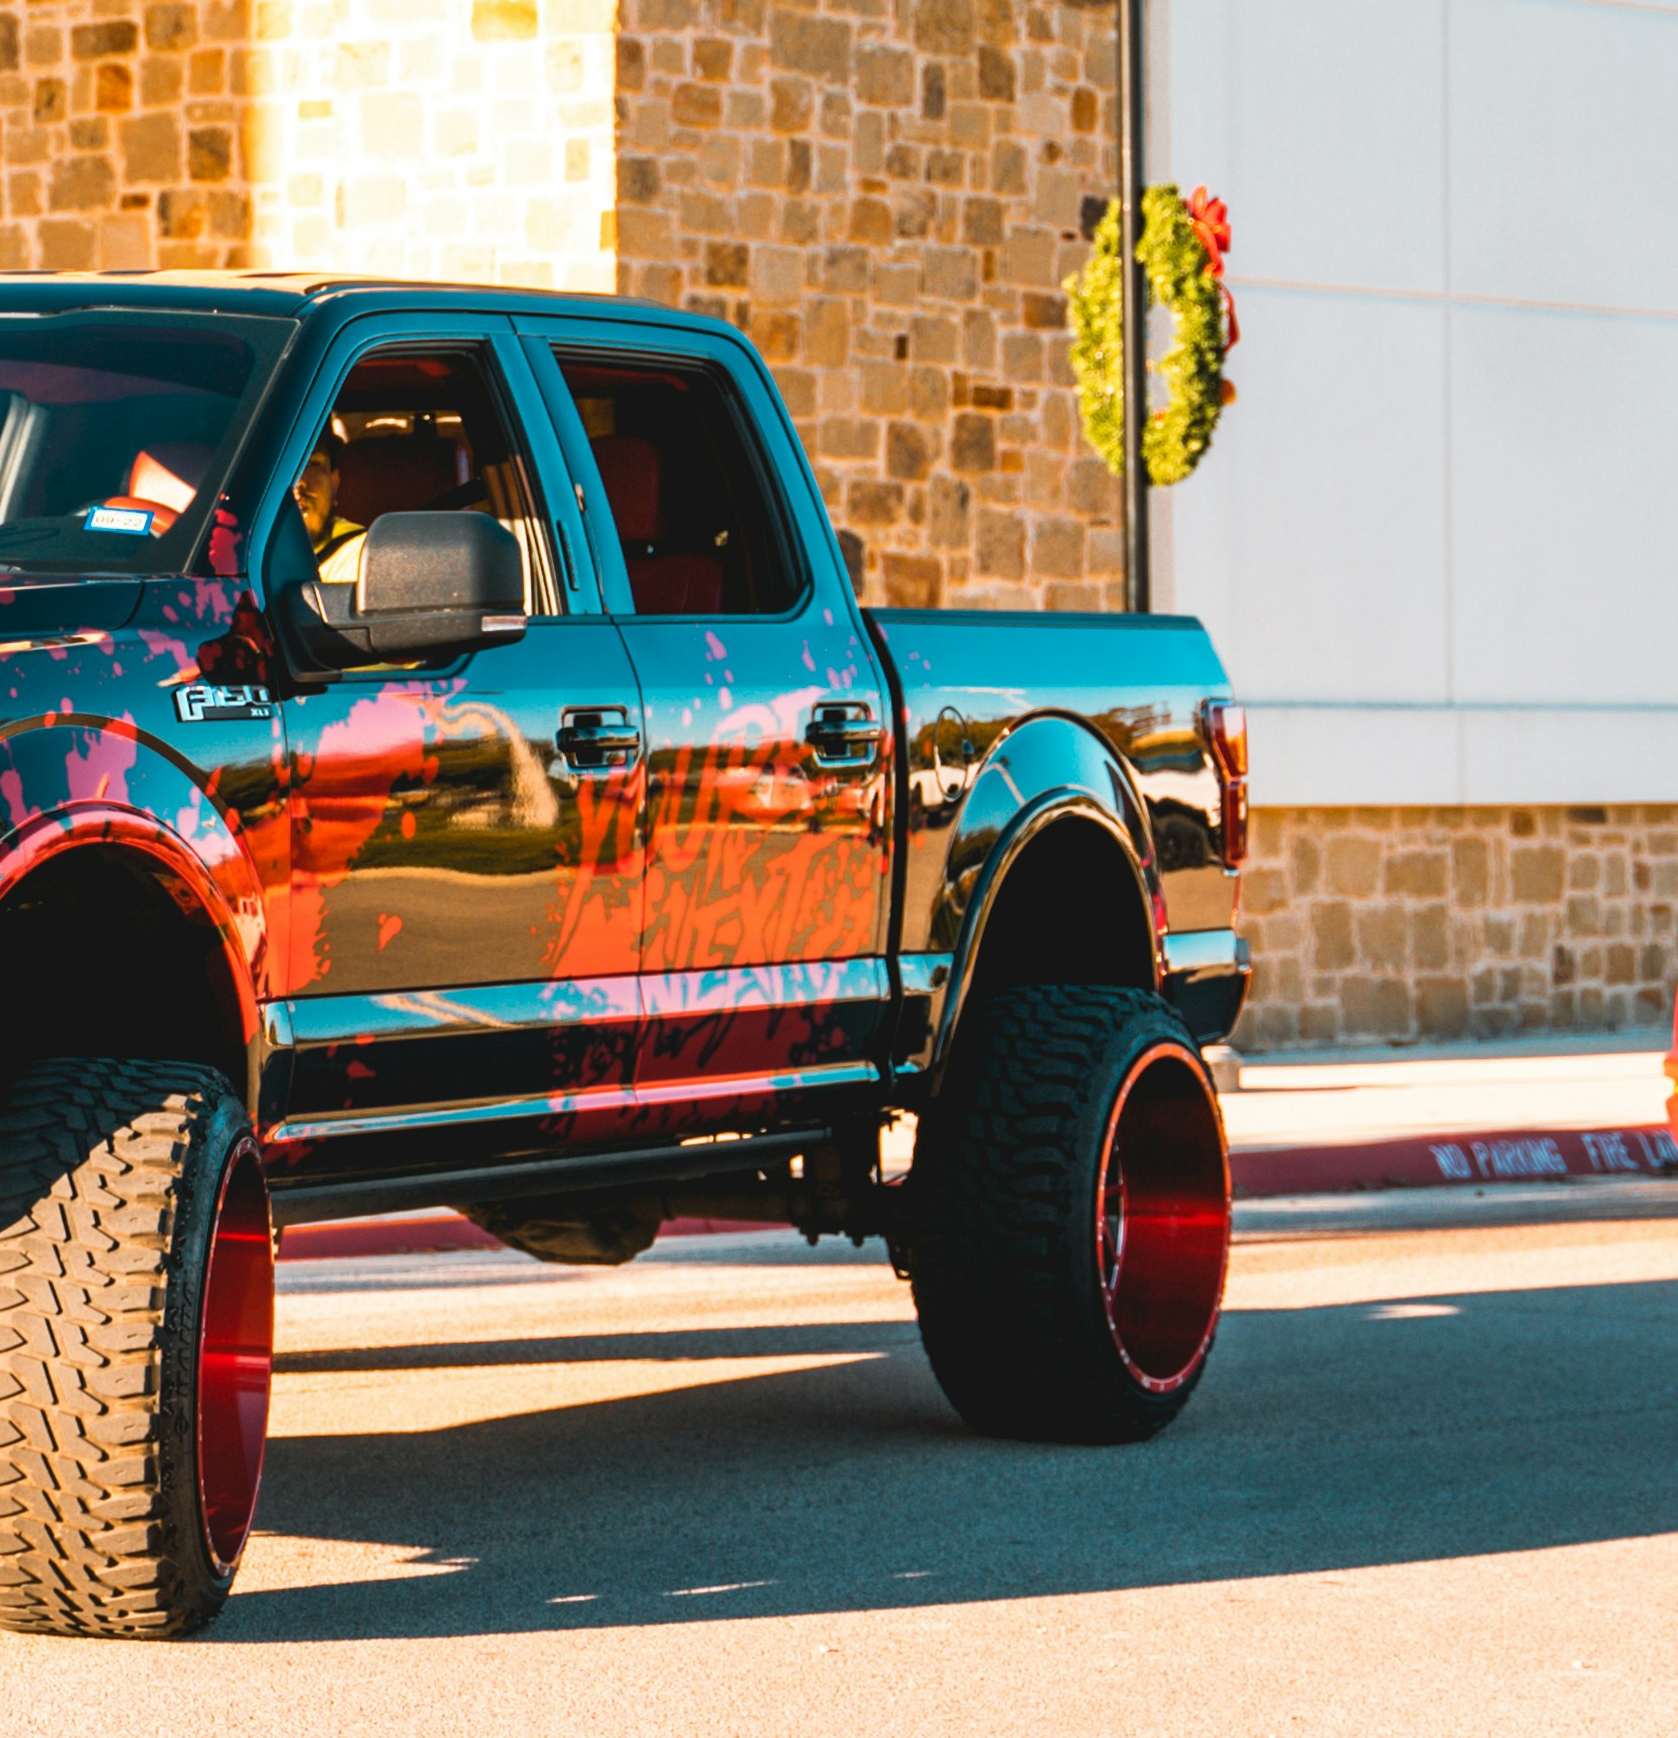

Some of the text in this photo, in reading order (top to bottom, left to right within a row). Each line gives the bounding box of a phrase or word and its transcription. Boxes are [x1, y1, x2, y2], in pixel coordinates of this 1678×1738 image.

[1428, 1143, 1472, 1179] NO
[1469, 1137, 1567, 1177] PARKING
[1581, 1130, 1639, 1170] FIRE
